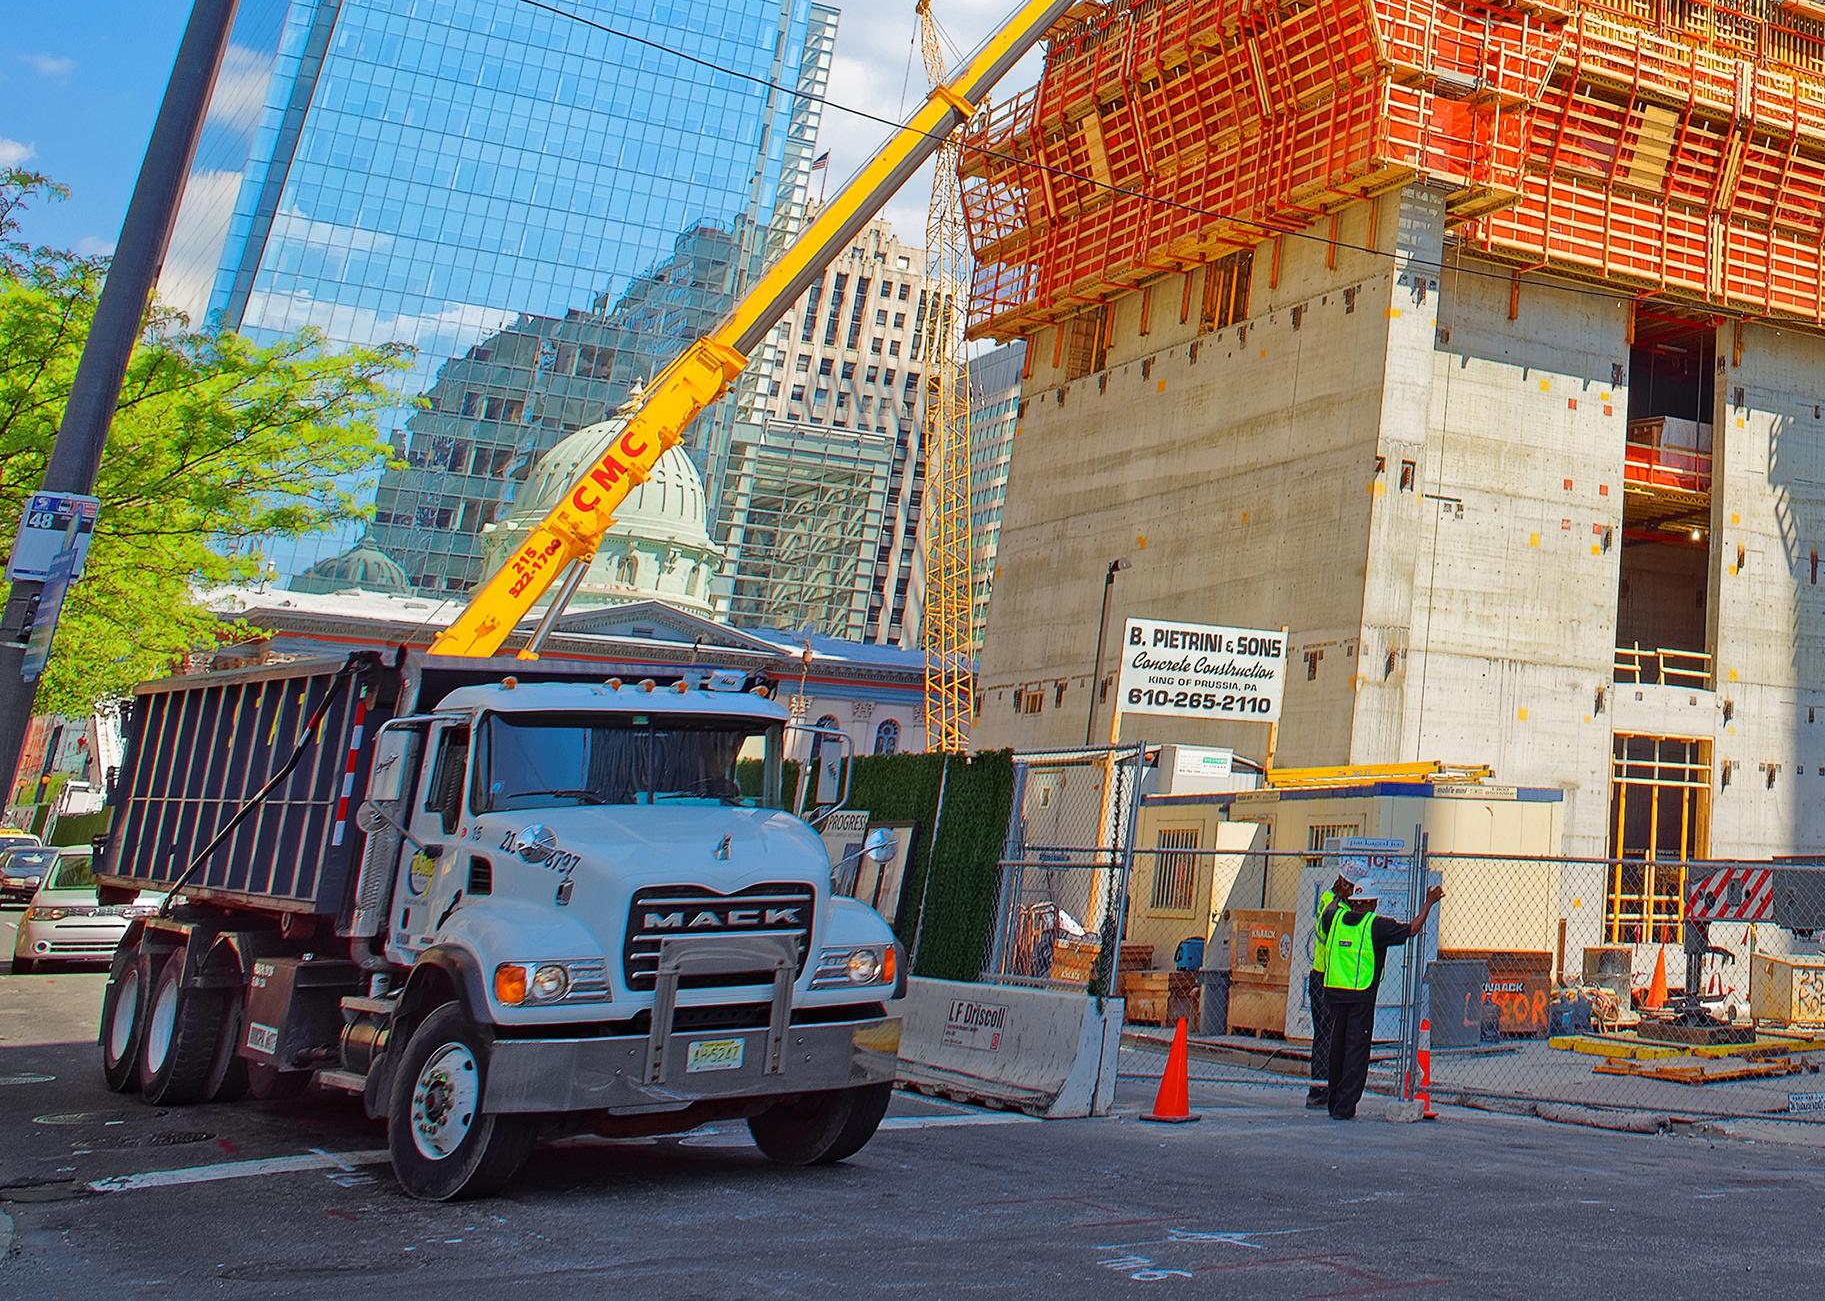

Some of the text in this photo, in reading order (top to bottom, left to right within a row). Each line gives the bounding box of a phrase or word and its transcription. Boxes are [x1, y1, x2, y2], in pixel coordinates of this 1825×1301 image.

[572, 431, 648, 513] CMC
[29, 512, 55, 529] 48
[511, 546, 538, 575] 215
[1129, 626, 1146, 647] B.
[1153, 628, 1223, 653] PIETRINI
[1237, 636, 1282, 658] SONS
[1132, 651, 1275, 680] Concrete Construction
[1148, 675, 1257, 692] KING OF PRUSSIA, PA
[1128, 688, 1271, 714] 610-265-2110
[643, 907, 801, 929] MACK
[964, 1003, 1006, 1029] Driscoll
